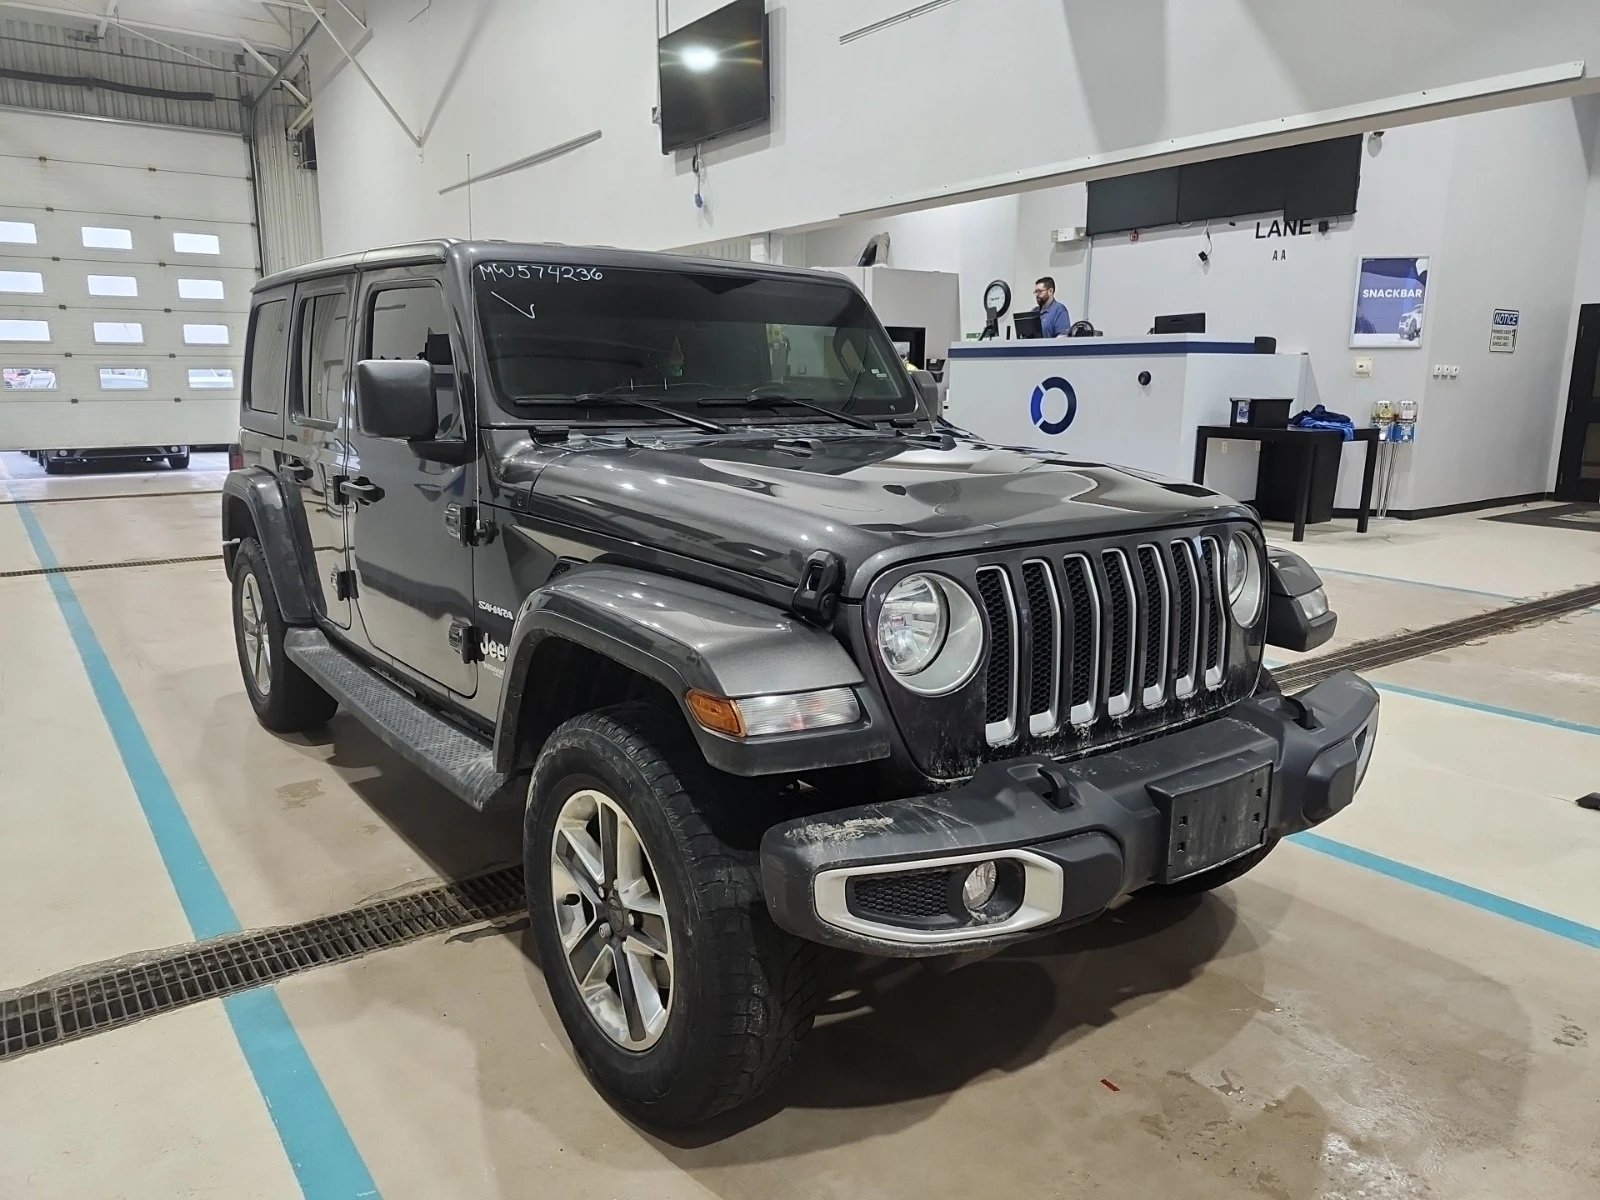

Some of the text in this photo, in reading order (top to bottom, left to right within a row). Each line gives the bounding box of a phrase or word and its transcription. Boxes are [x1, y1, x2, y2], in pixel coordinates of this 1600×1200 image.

[1255, 219, 1312, 239] LANE
[478, 264, 603, 283] MW574236
[1362, 288, 1423, 298] SNACKBAR
[1495, 313, 1518, 325] NOTICE
[478, 600, 514, 620] SAHARA
